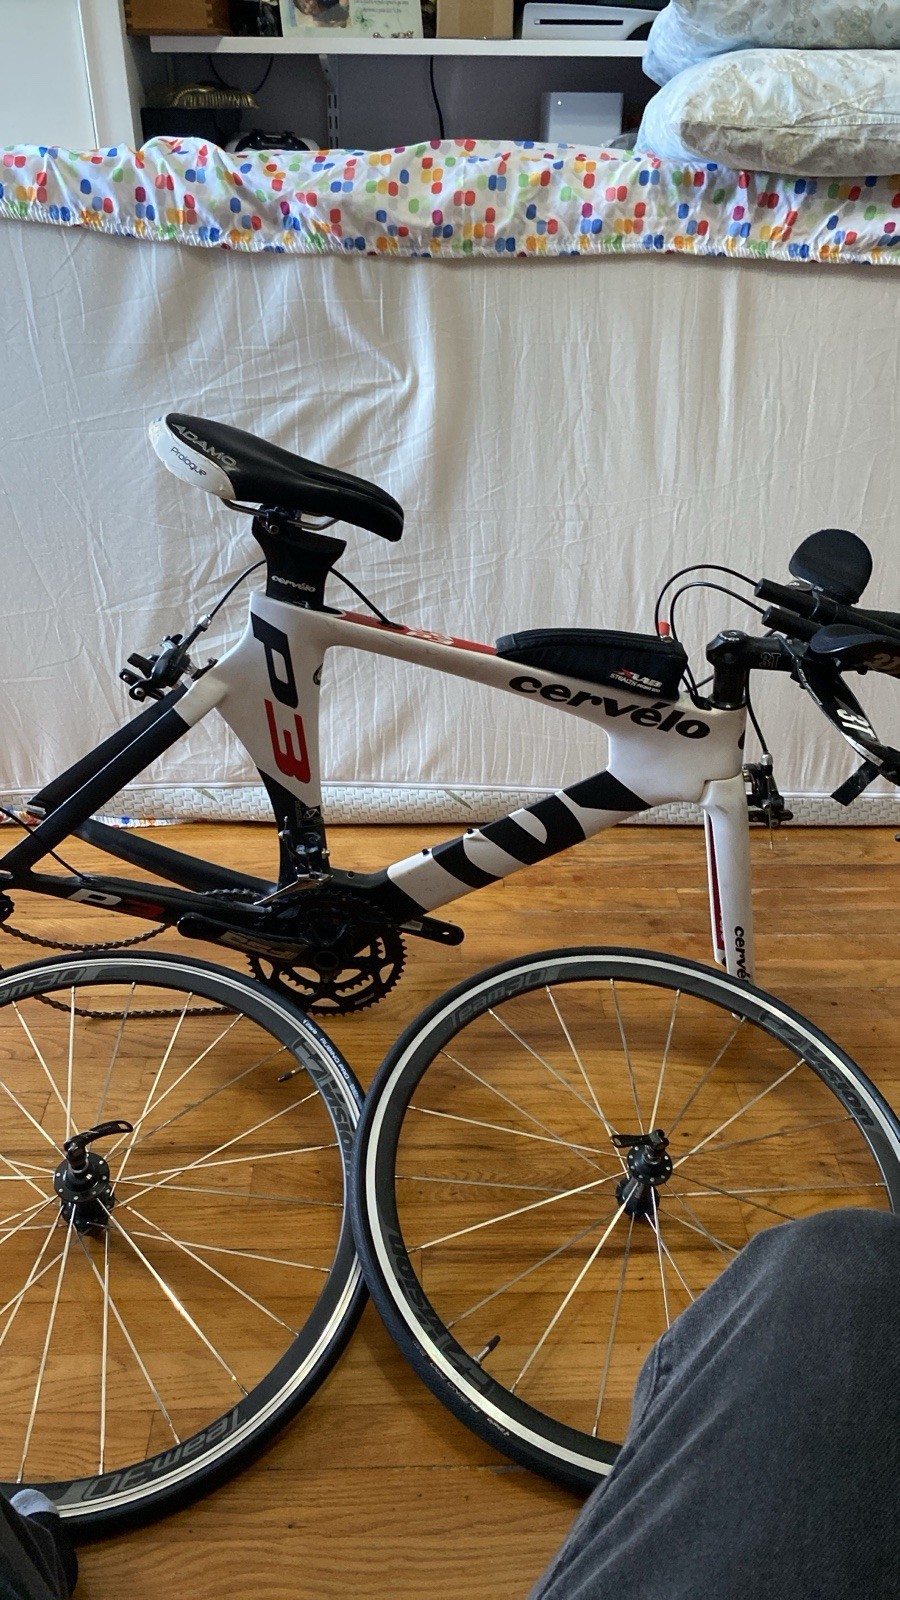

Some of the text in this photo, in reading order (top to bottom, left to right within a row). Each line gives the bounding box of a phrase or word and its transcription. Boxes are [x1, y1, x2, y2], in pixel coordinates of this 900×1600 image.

[170, 446, 208, 477] Prologue
[172, 424, 237, 469] ADAMO
[250, 611, 311, 784] P3
[509, 676, 710, 739] cervélo
[734, 925, 751, 983] cervé
